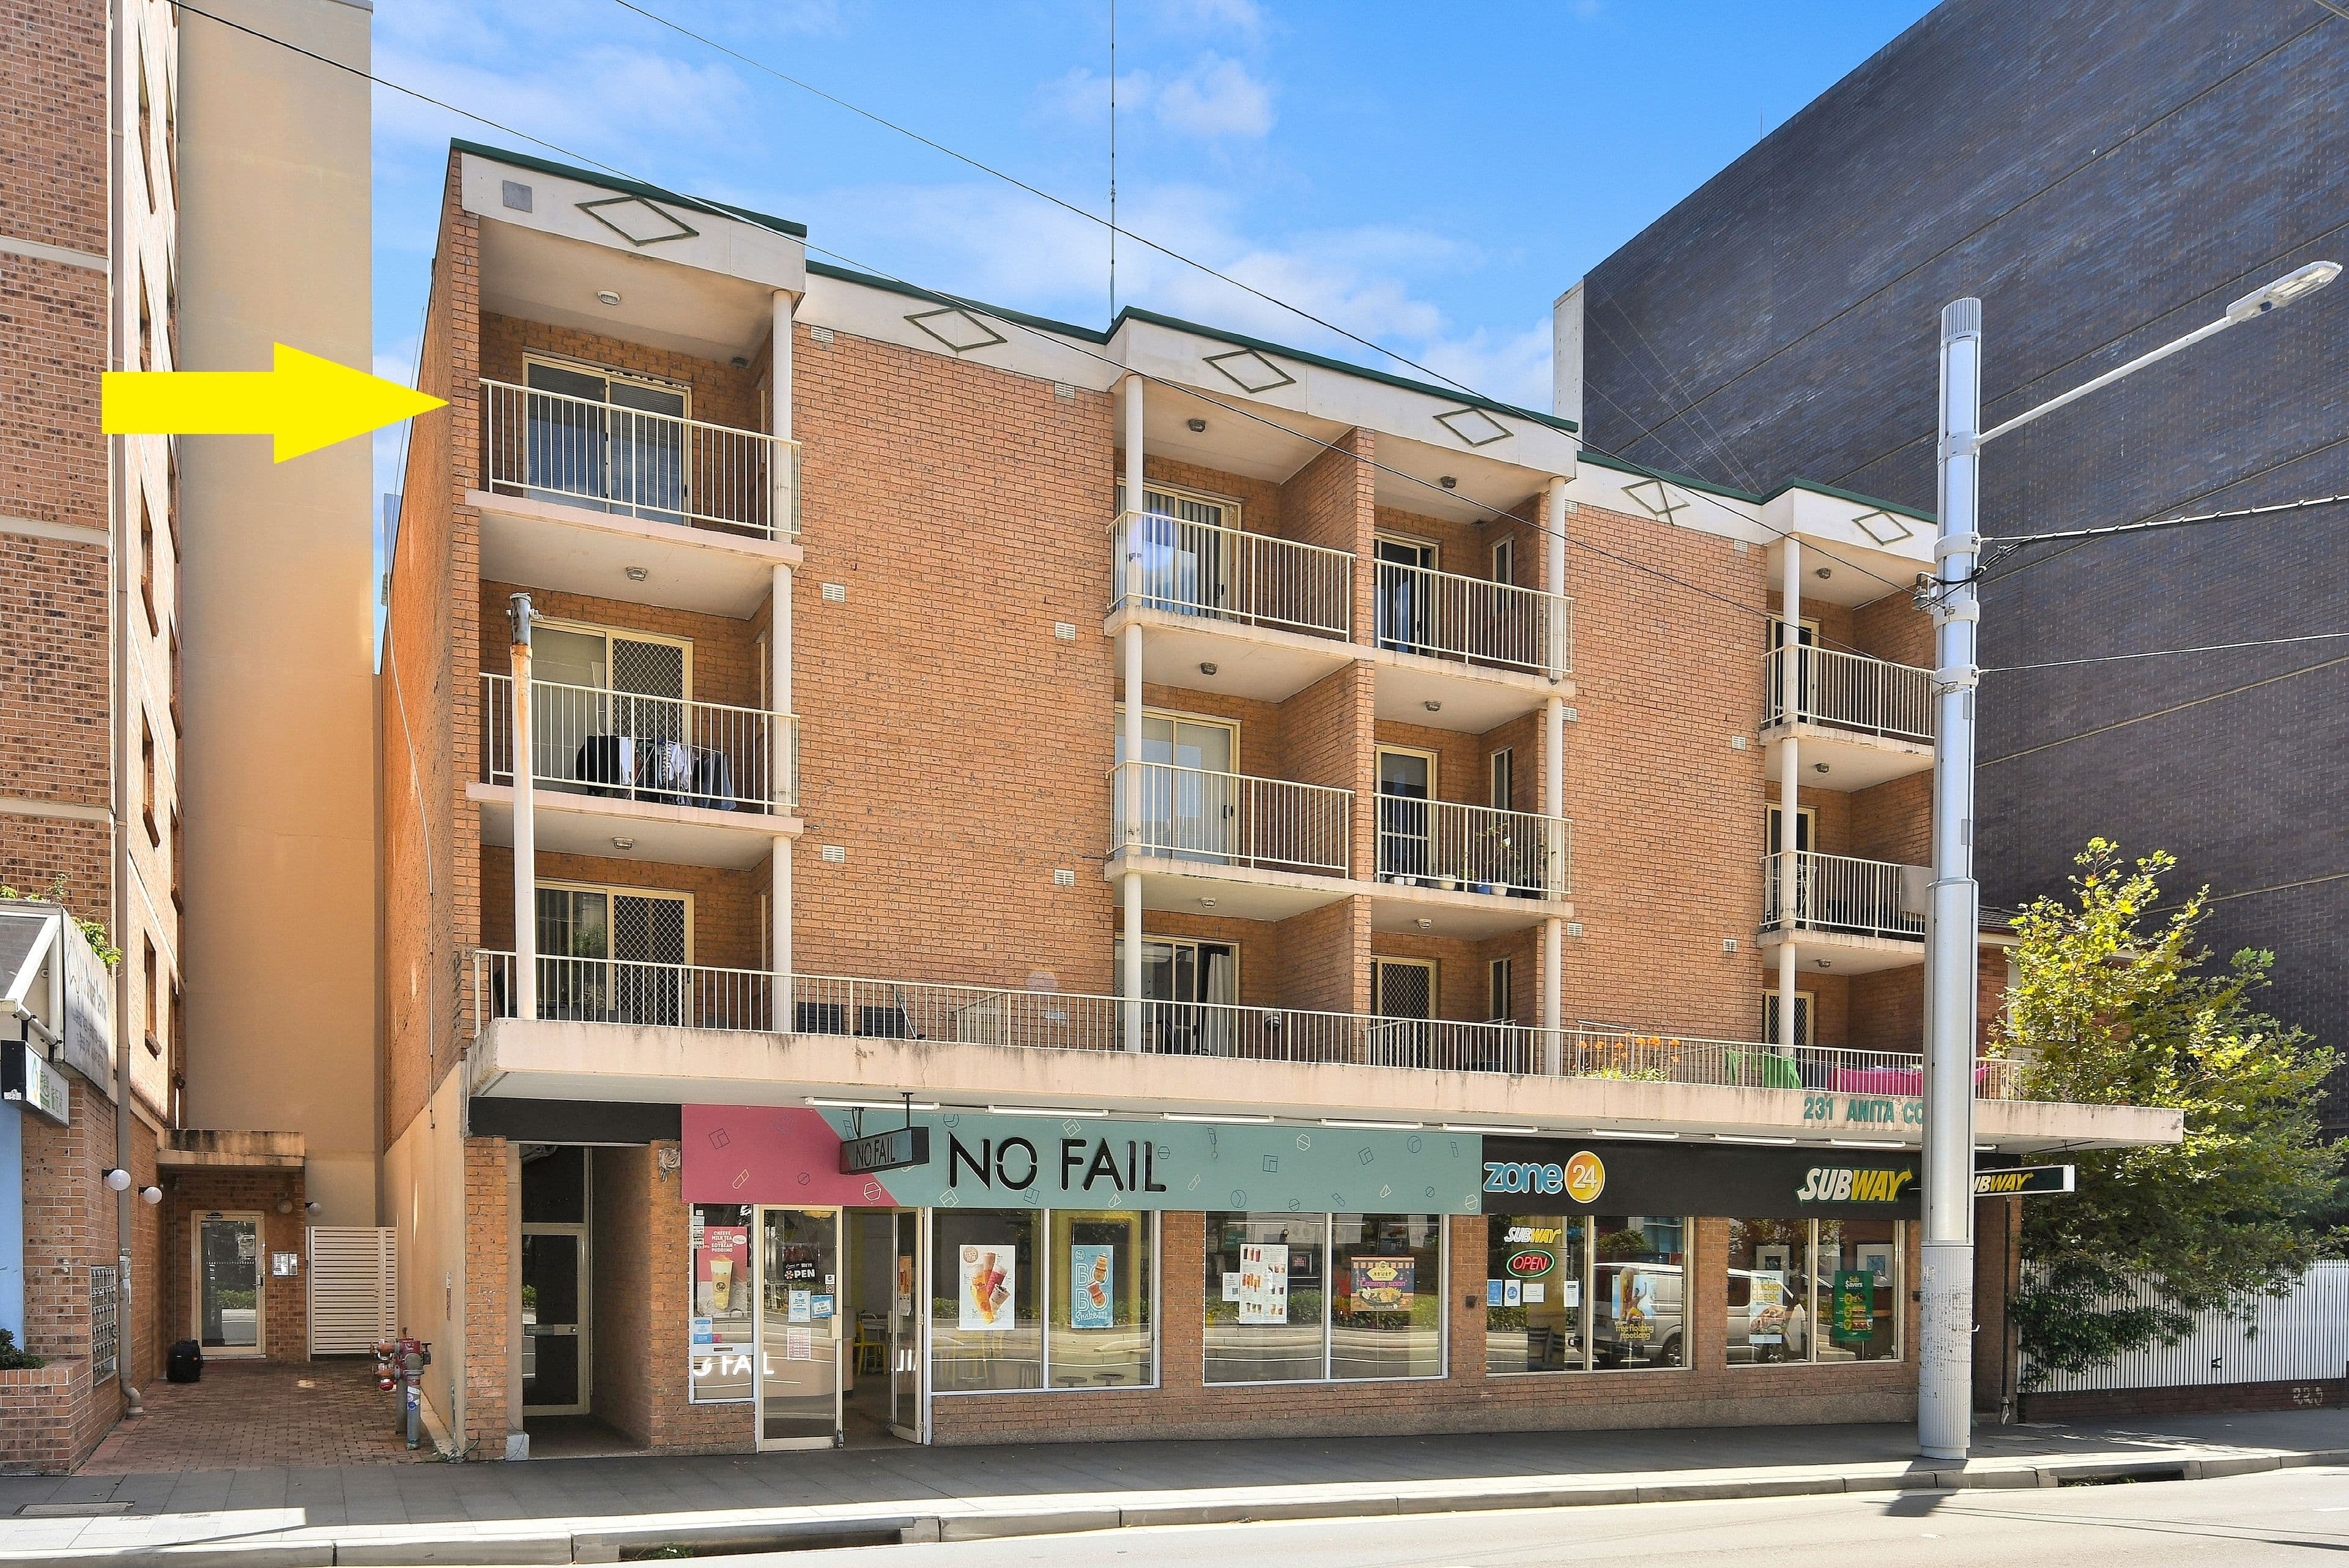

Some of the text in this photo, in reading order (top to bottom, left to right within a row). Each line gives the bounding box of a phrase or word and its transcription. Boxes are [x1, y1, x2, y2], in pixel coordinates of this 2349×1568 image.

[1803, 1096, 1923, 1124] 231 ANITA CO
[856, 1136, 896, 1168] NO FAIL
[948, 1132, 1167, 1192] NO FAIL
[1483, 1162, 1598, 1195] zone 24
[1797, 1167, 1913, 1202] SUBWAY
[1974, 1172, 2035, 1193] UBWAY
[1504, 1227, 1562, 1244] SUBWAY
[1512, 1256, 1548, 1271] OPEN
[1076, 1310, 1099, 1322] Shake
